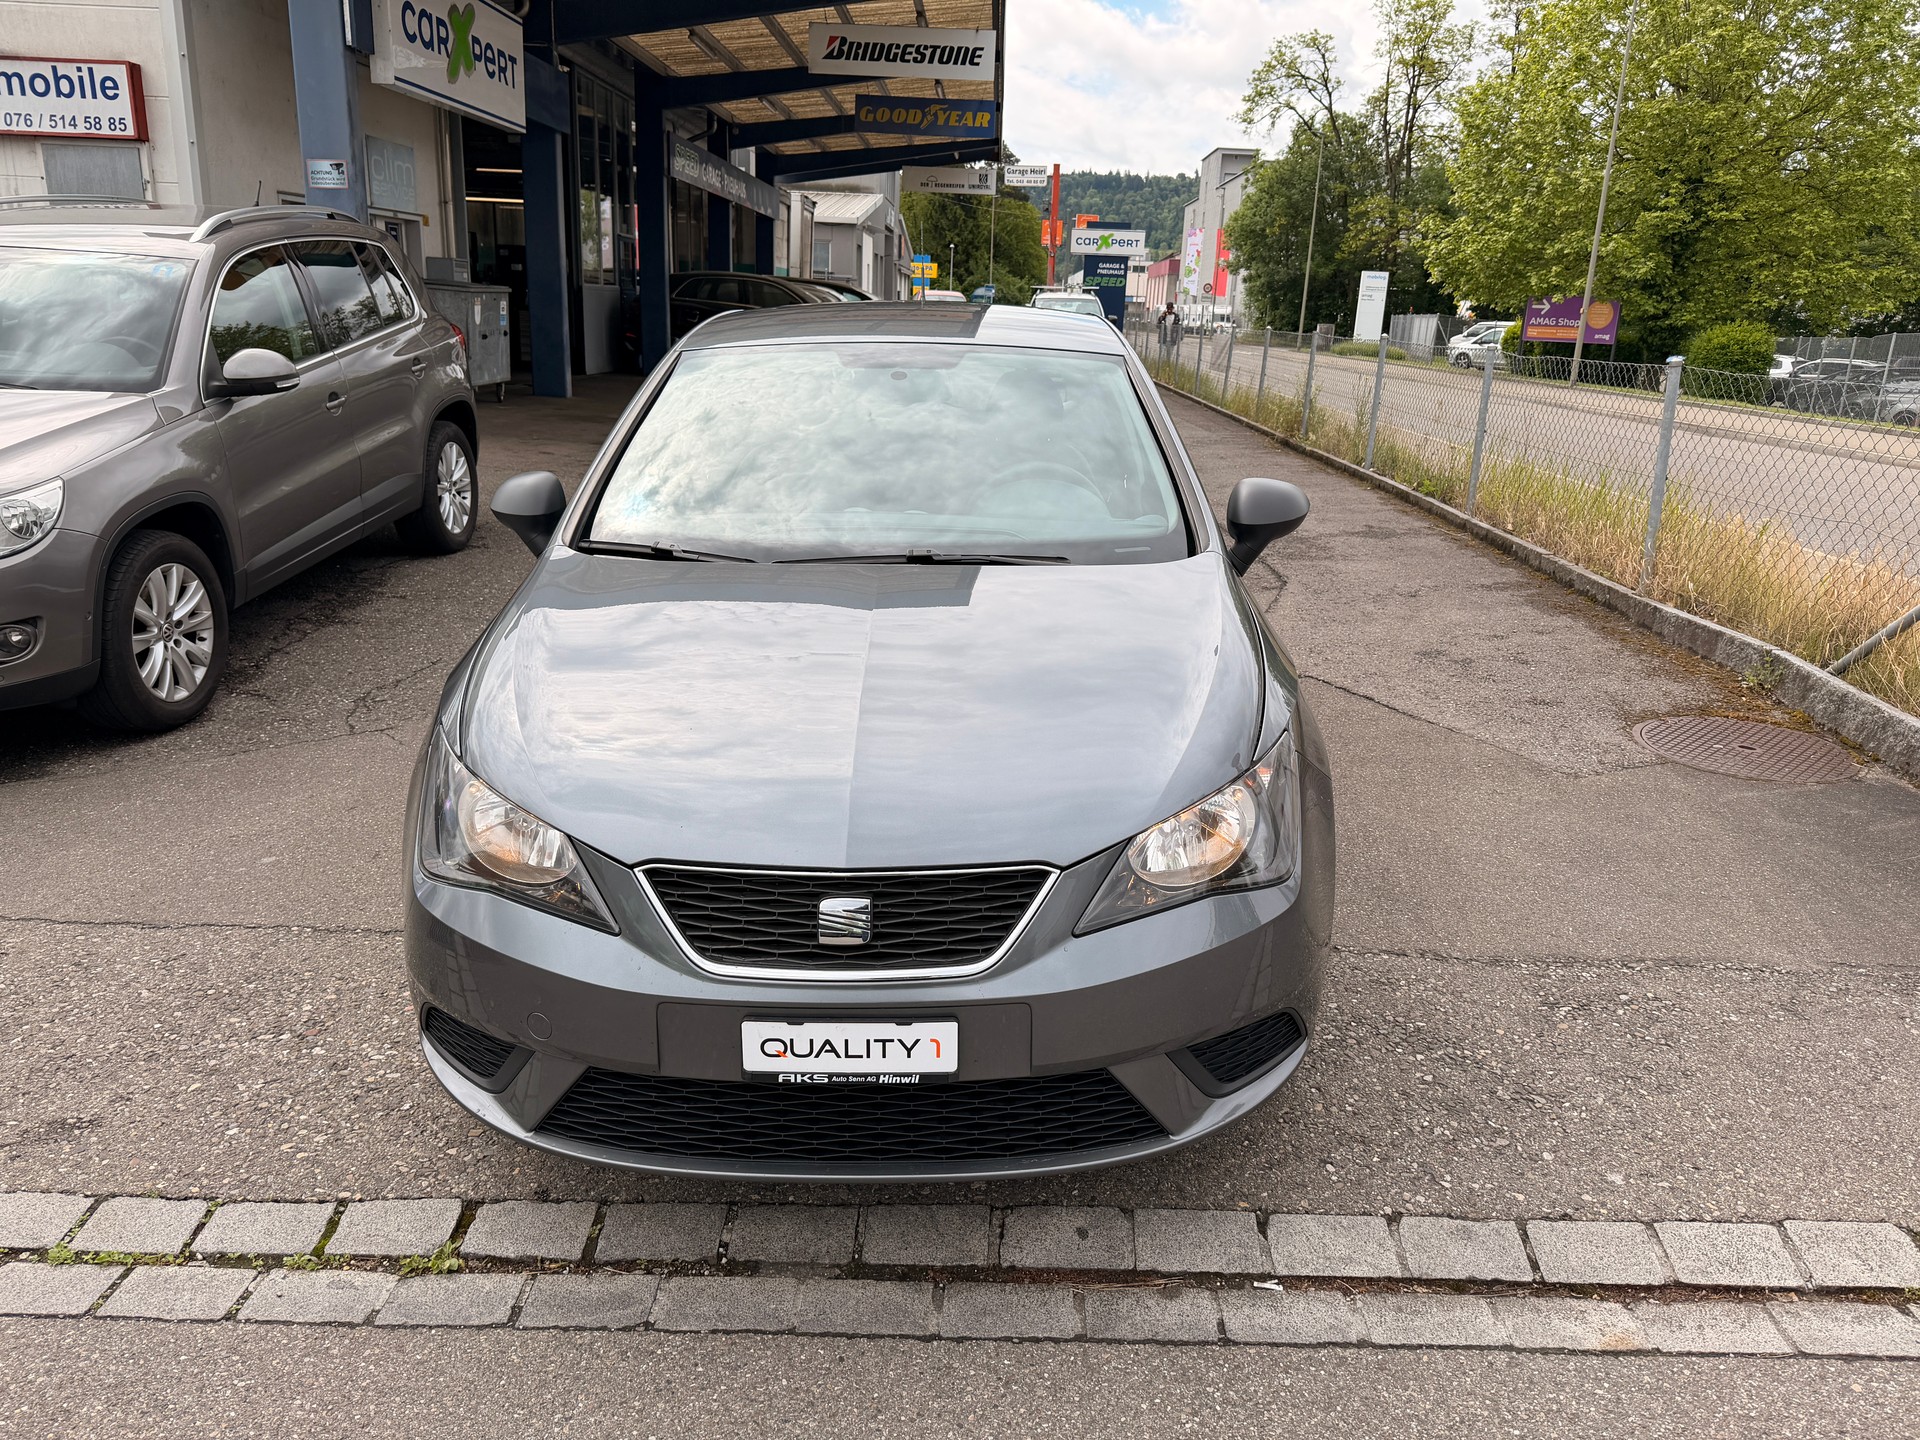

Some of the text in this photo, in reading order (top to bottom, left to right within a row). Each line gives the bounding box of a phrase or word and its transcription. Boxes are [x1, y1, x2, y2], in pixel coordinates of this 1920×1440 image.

[822, 35, 984, 66] BRIDGESTONE
[0, 65, 120, 101] mobile
[4, 112, 33, 128] 076
[49, 114, 78, 130] 514
[83, 116, 102, 131] 58
[108, 117, 127, 132] 85
[1006, 167, 1029, 176] Garage
[1084, 276, 1126, 288] SPEED
[1529, 317, 1580, 328] AMAG Shop
[760, 1038, 941, 1059] QUALITY 1
[778, 1074, 829, 1083] AKS
[831, 1075, 847, 1083] Auto
[848, 1075, 866, 1083] Senn
[879, 1074, 920, 1084] Hinwil
